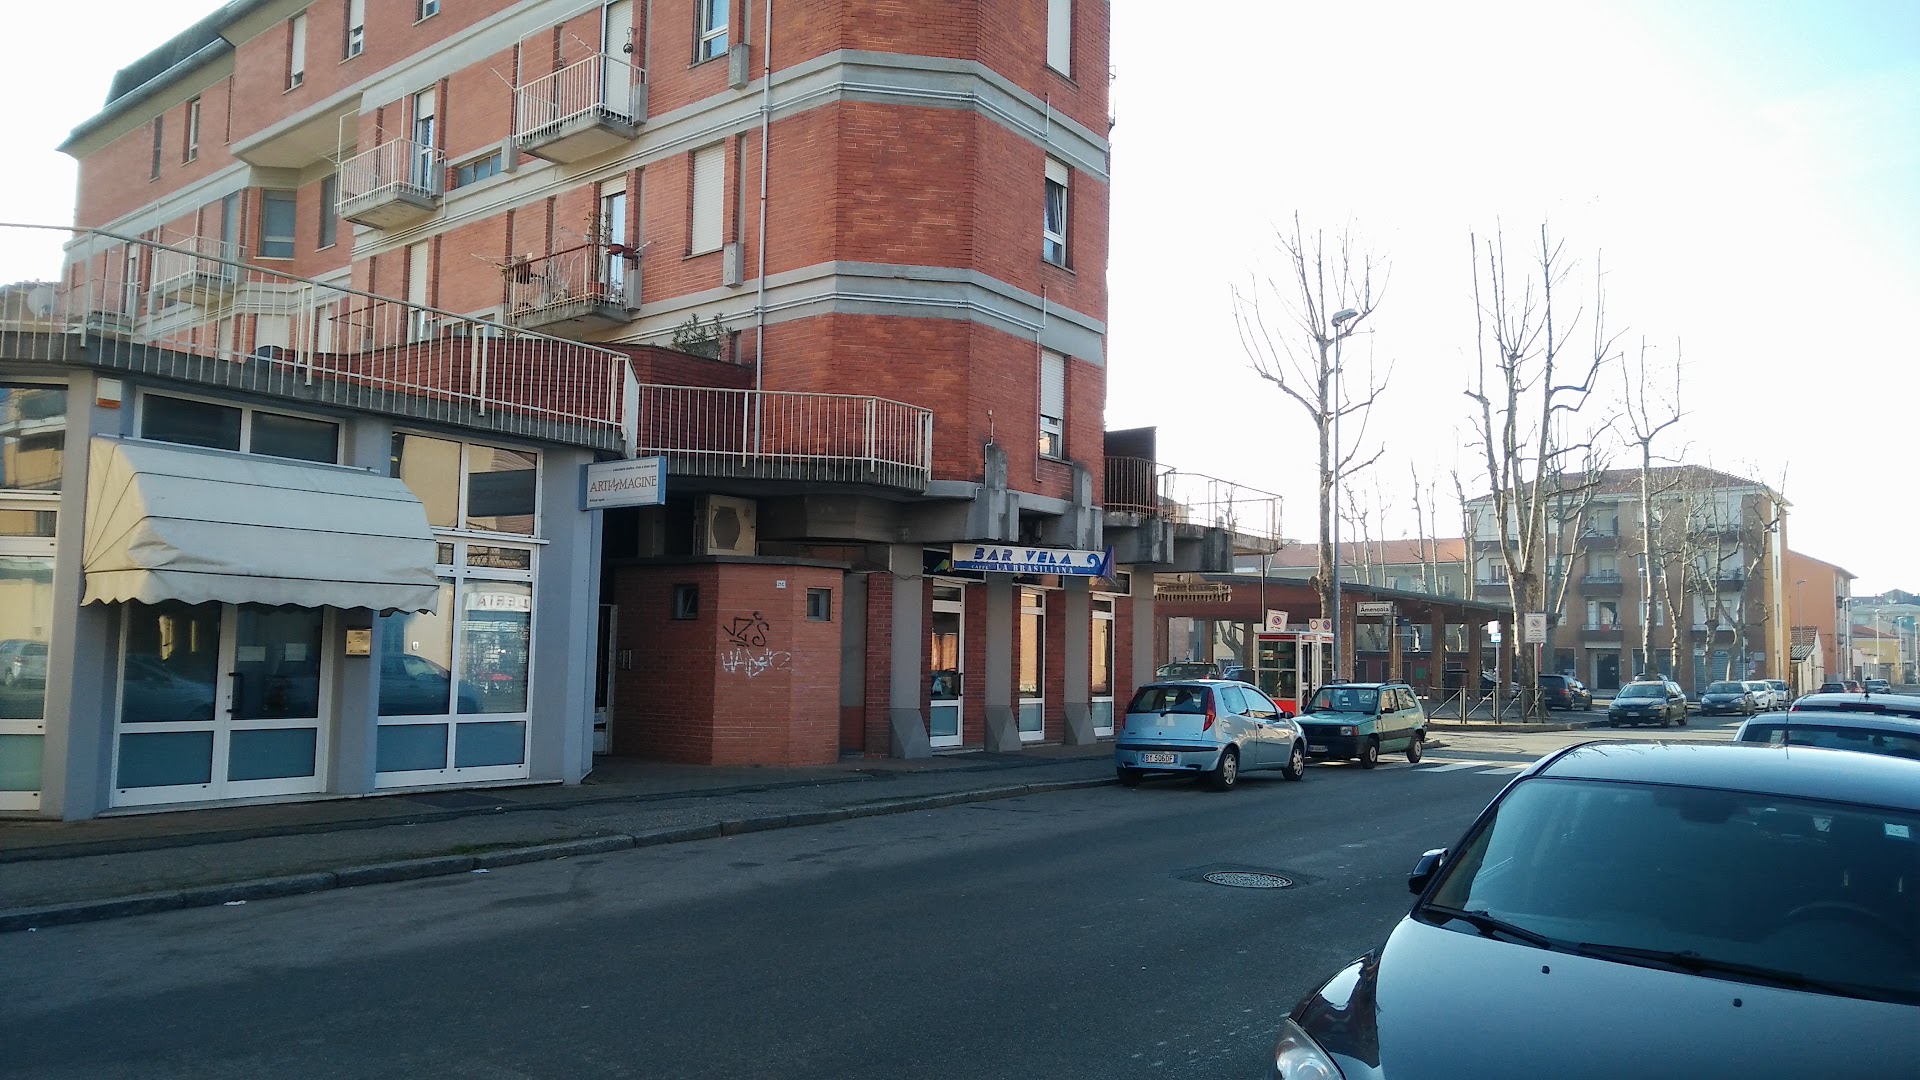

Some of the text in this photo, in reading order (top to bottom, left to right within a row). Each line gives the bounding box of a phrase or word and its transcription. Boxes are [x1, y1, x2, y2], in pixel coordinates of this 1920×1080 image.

[974, 547, 1071, 564] BAR VELA
[996, 563, 1008, 571] LA
[1013, 564, 1074, 574] BRASILIANA
